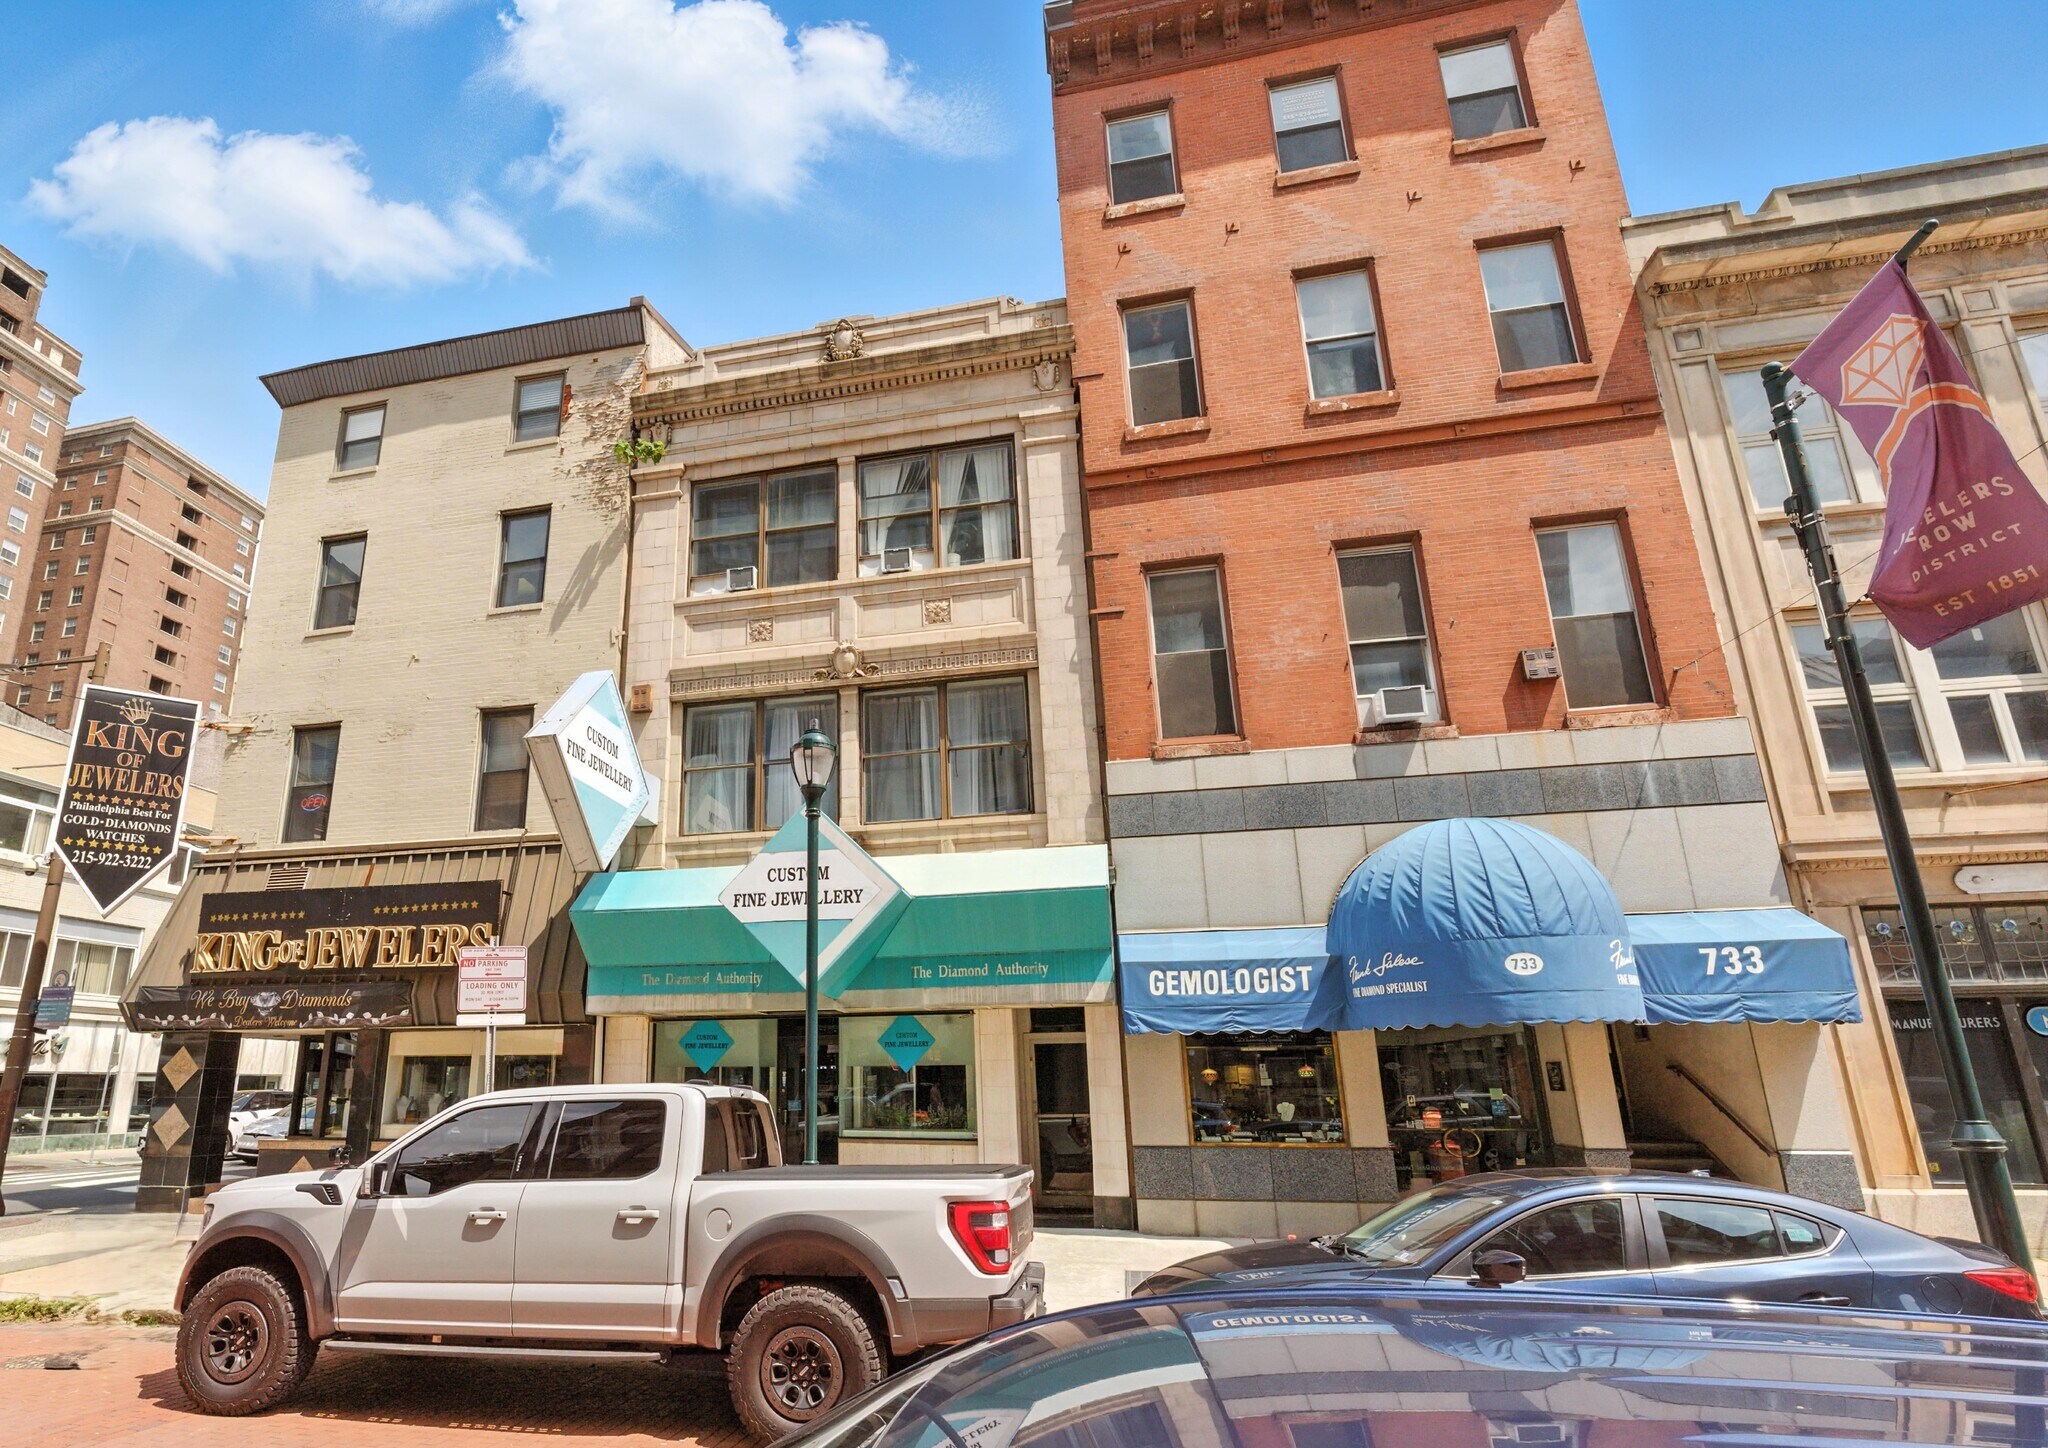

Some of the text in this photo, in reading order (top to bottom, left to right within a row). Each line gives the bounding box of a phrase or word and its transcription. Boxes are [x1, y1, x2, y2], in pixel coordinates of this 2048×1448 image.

[1893, 476, 2014, 555] JEELERS
[1918, 511, 1976, 552] ROW
[1912, 523, 2021, 583] DISTRICT
[1933, 564, 2039, 617] EST 1851
[83, 720, 186, 758] KING
[586, 725, 619, 760] CUSTOM
[117, 752, 146, 769] OF
[566, 738, 633, 793] FINE JEWELLERY
[68, 763, 184, 800] JEWELERS
[69, 801, 173, 820] Philadelphia Best For
[301, 796, 328, 808] OPEN
[86, 829, 146, 844] WATCHES
[72, 850, 152, 869] 215-922-3222
[767, 866, 830, 882] CUSTM
[733, 889, 863, 908] FINE JEWLERY
[190, 930, 282, 973] KING
[278, 939, 304, 963] OF
[1699, 945, 1764, 976] 733
[912, 961, 1049, 979] The Diamond Authority
[1511, 958, 1537, 970] 733
[466, 982, 497, 990] LOADING
[642, 974, 660, 986] The
[716, 971, 763, 987] Authority
[1149, 965, 1313, 996] GEMOLOGIST
[1385, 981, 1427, 994] SPECIALIST
[191, 988, 353, 1014] We Buy Diamonds
[1892, 1016, 2001, 1030] MANUFURERS
